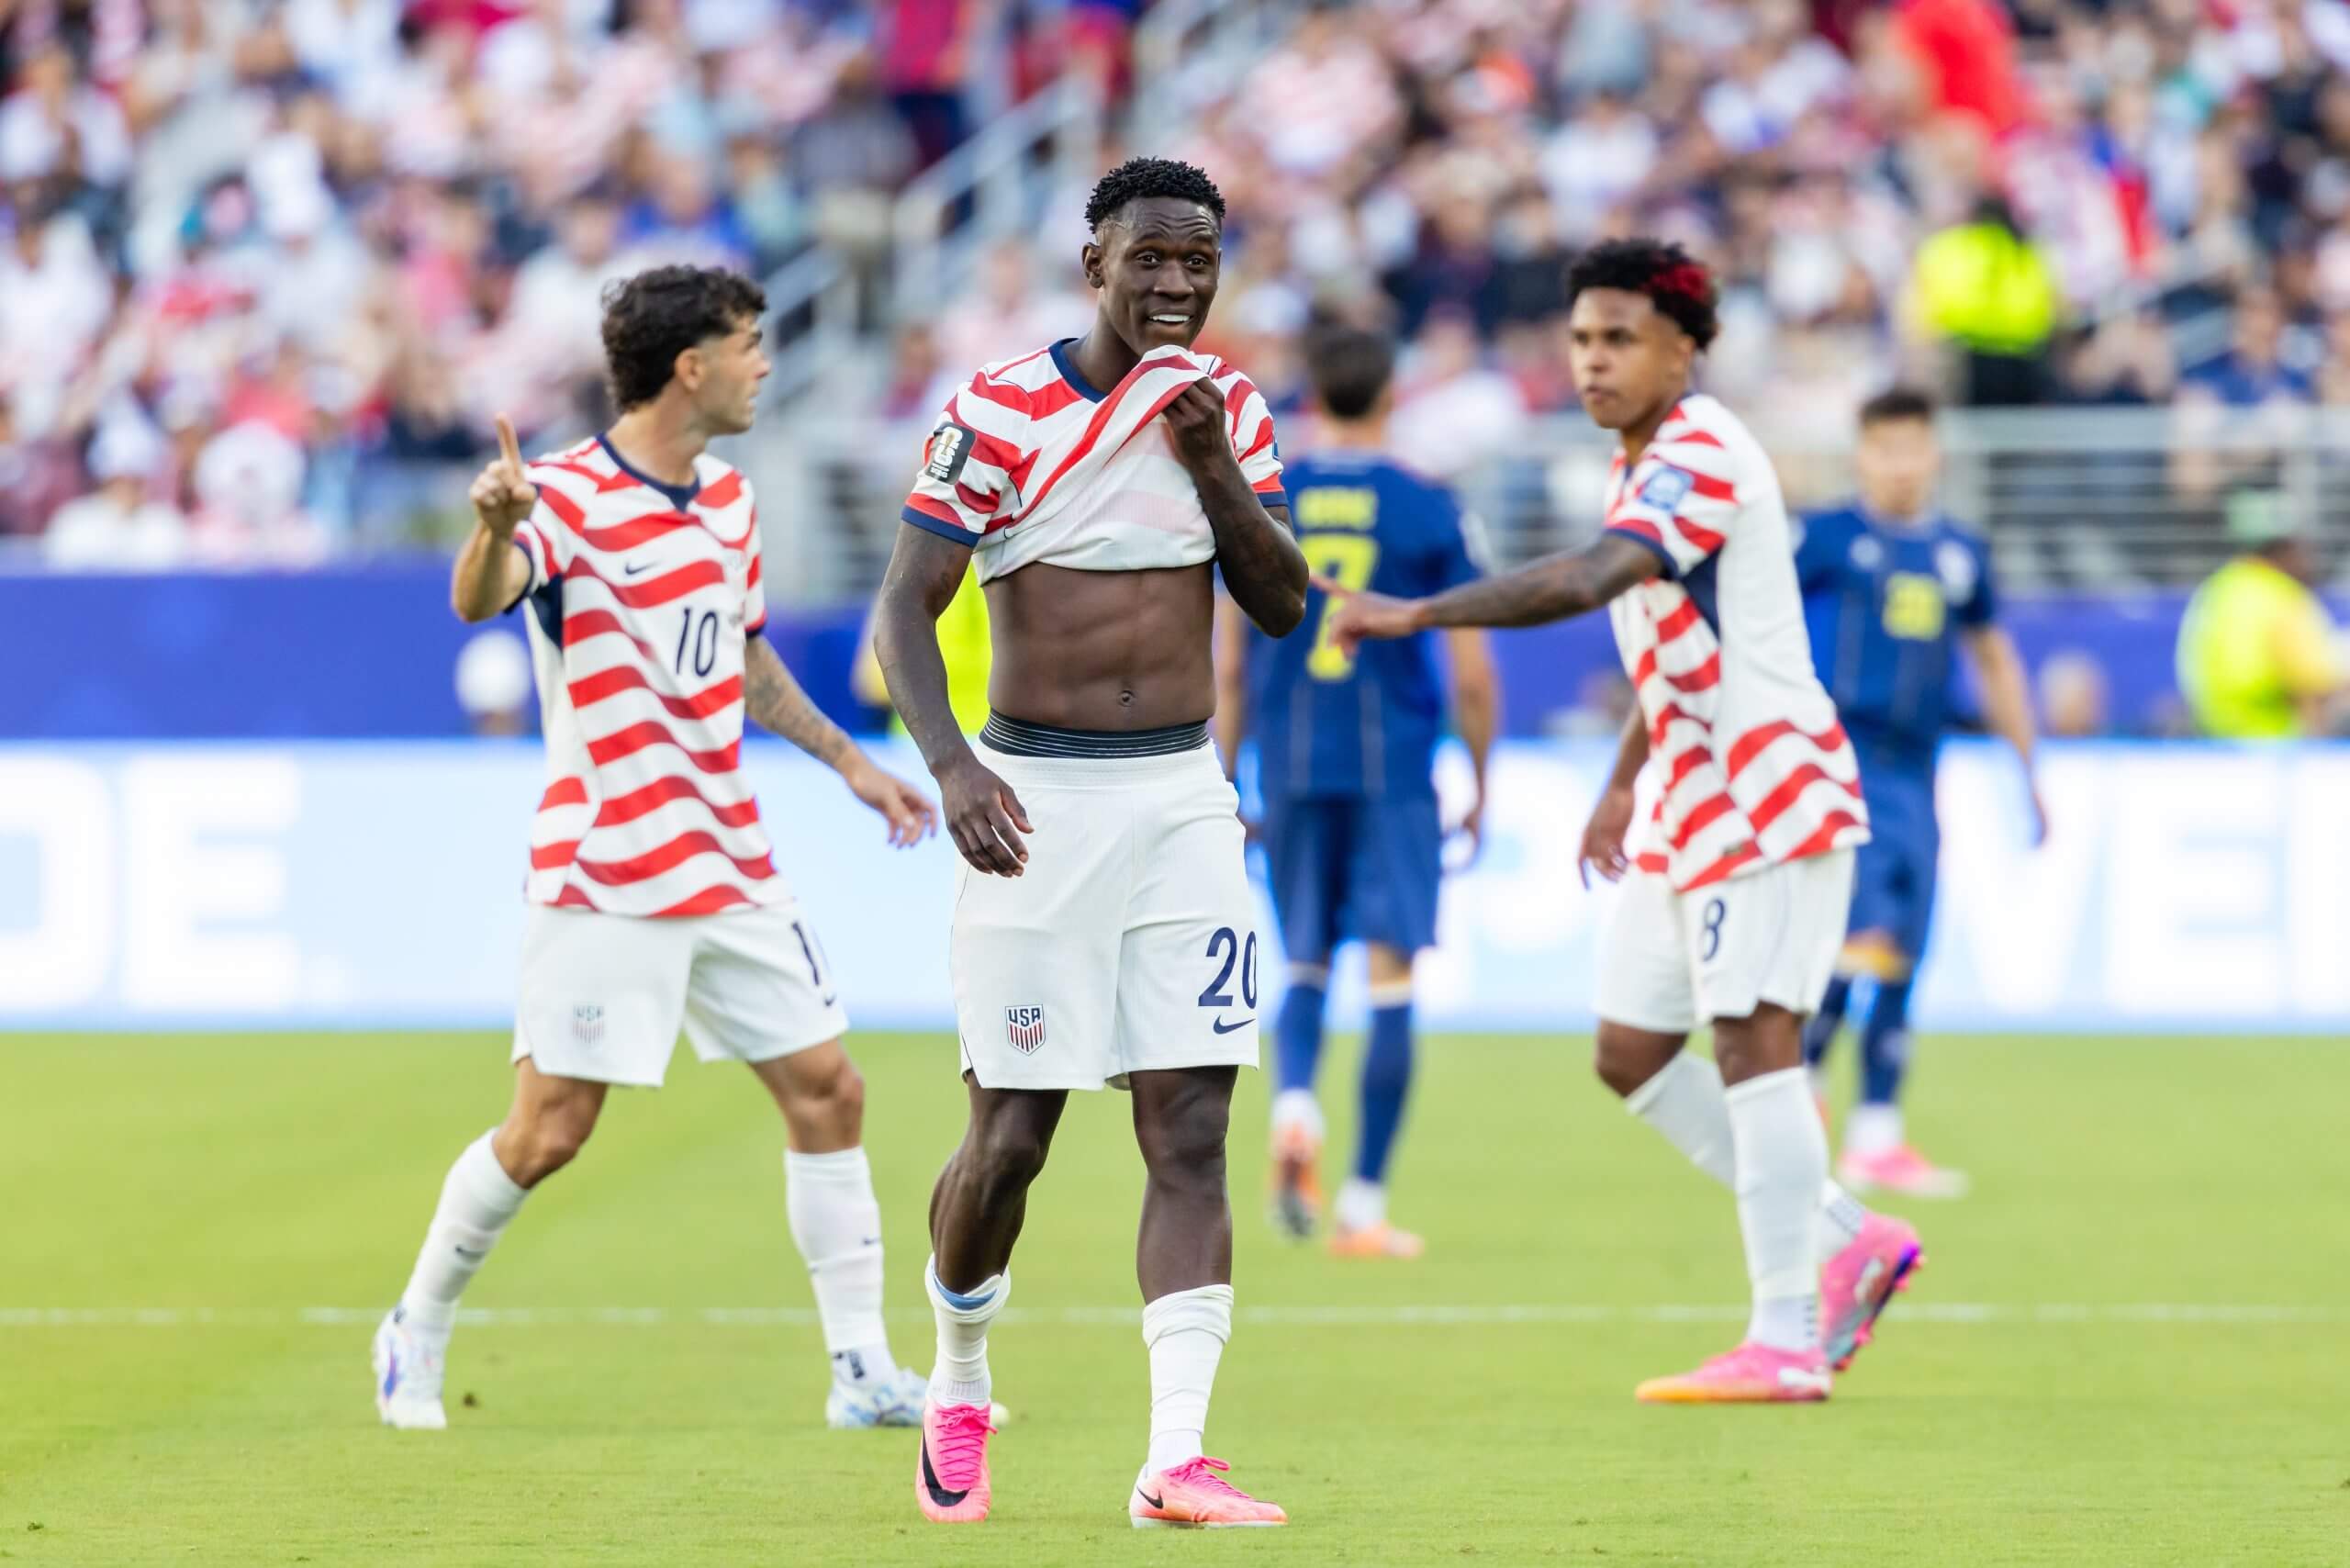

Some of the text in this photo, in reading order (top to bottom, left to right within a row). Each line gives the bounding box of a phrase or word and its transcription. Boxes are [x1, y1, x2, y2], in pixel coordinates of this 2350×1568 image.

[1300, 532, 1379, 681] 7
[677, 607, 718, 677] 10
[1698, 899, 1726, 963] 8
[1197, 927, 1257, 1009] 20
[1008, 1007, 1041, 1027] USA
